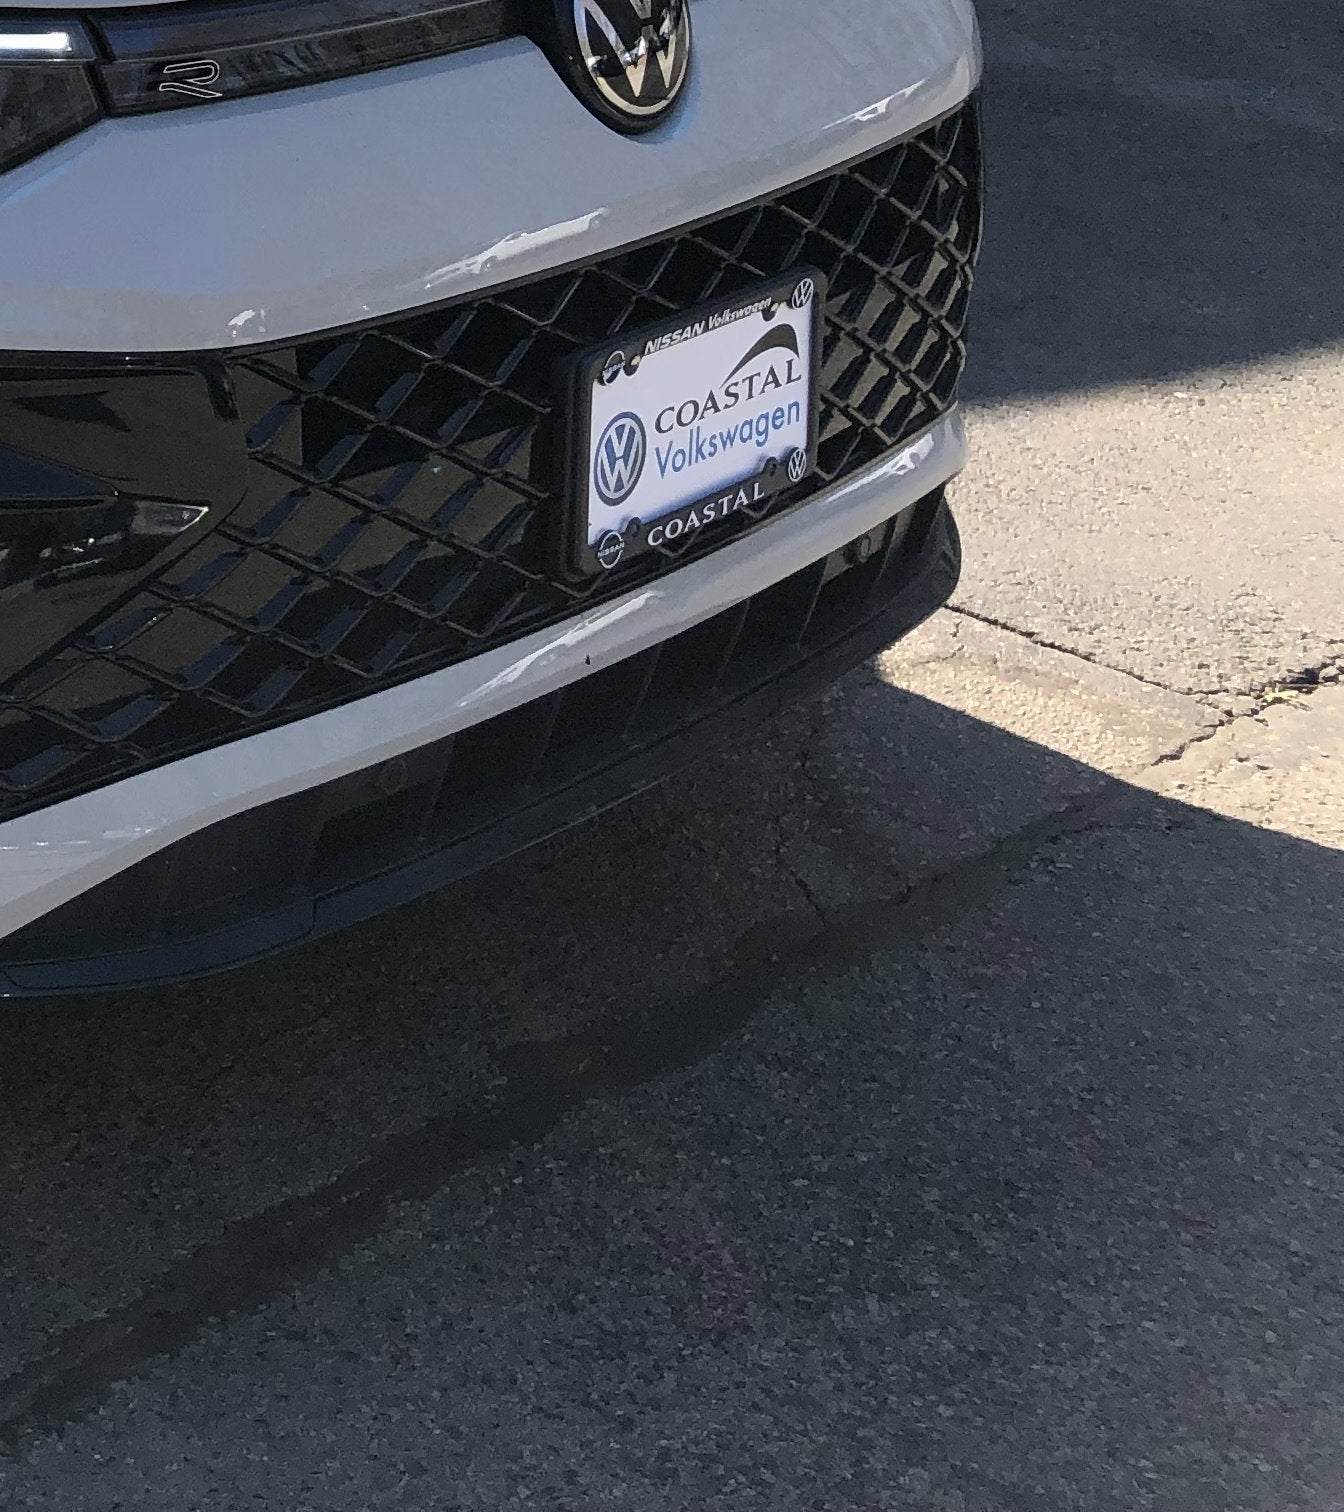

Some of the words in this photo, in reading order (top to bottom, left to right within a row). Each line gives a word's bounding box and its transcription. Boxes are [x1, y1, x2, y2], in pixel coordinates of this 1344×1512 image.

[644, 320, 705, 355] NISSAN
[708, 297, 772, 330] Volkswagen
[654, 359, 802, 435] COASTAL
[654, 400, 800, 480] Volkswagen
[647, 482, 765, 547] COASTAL
